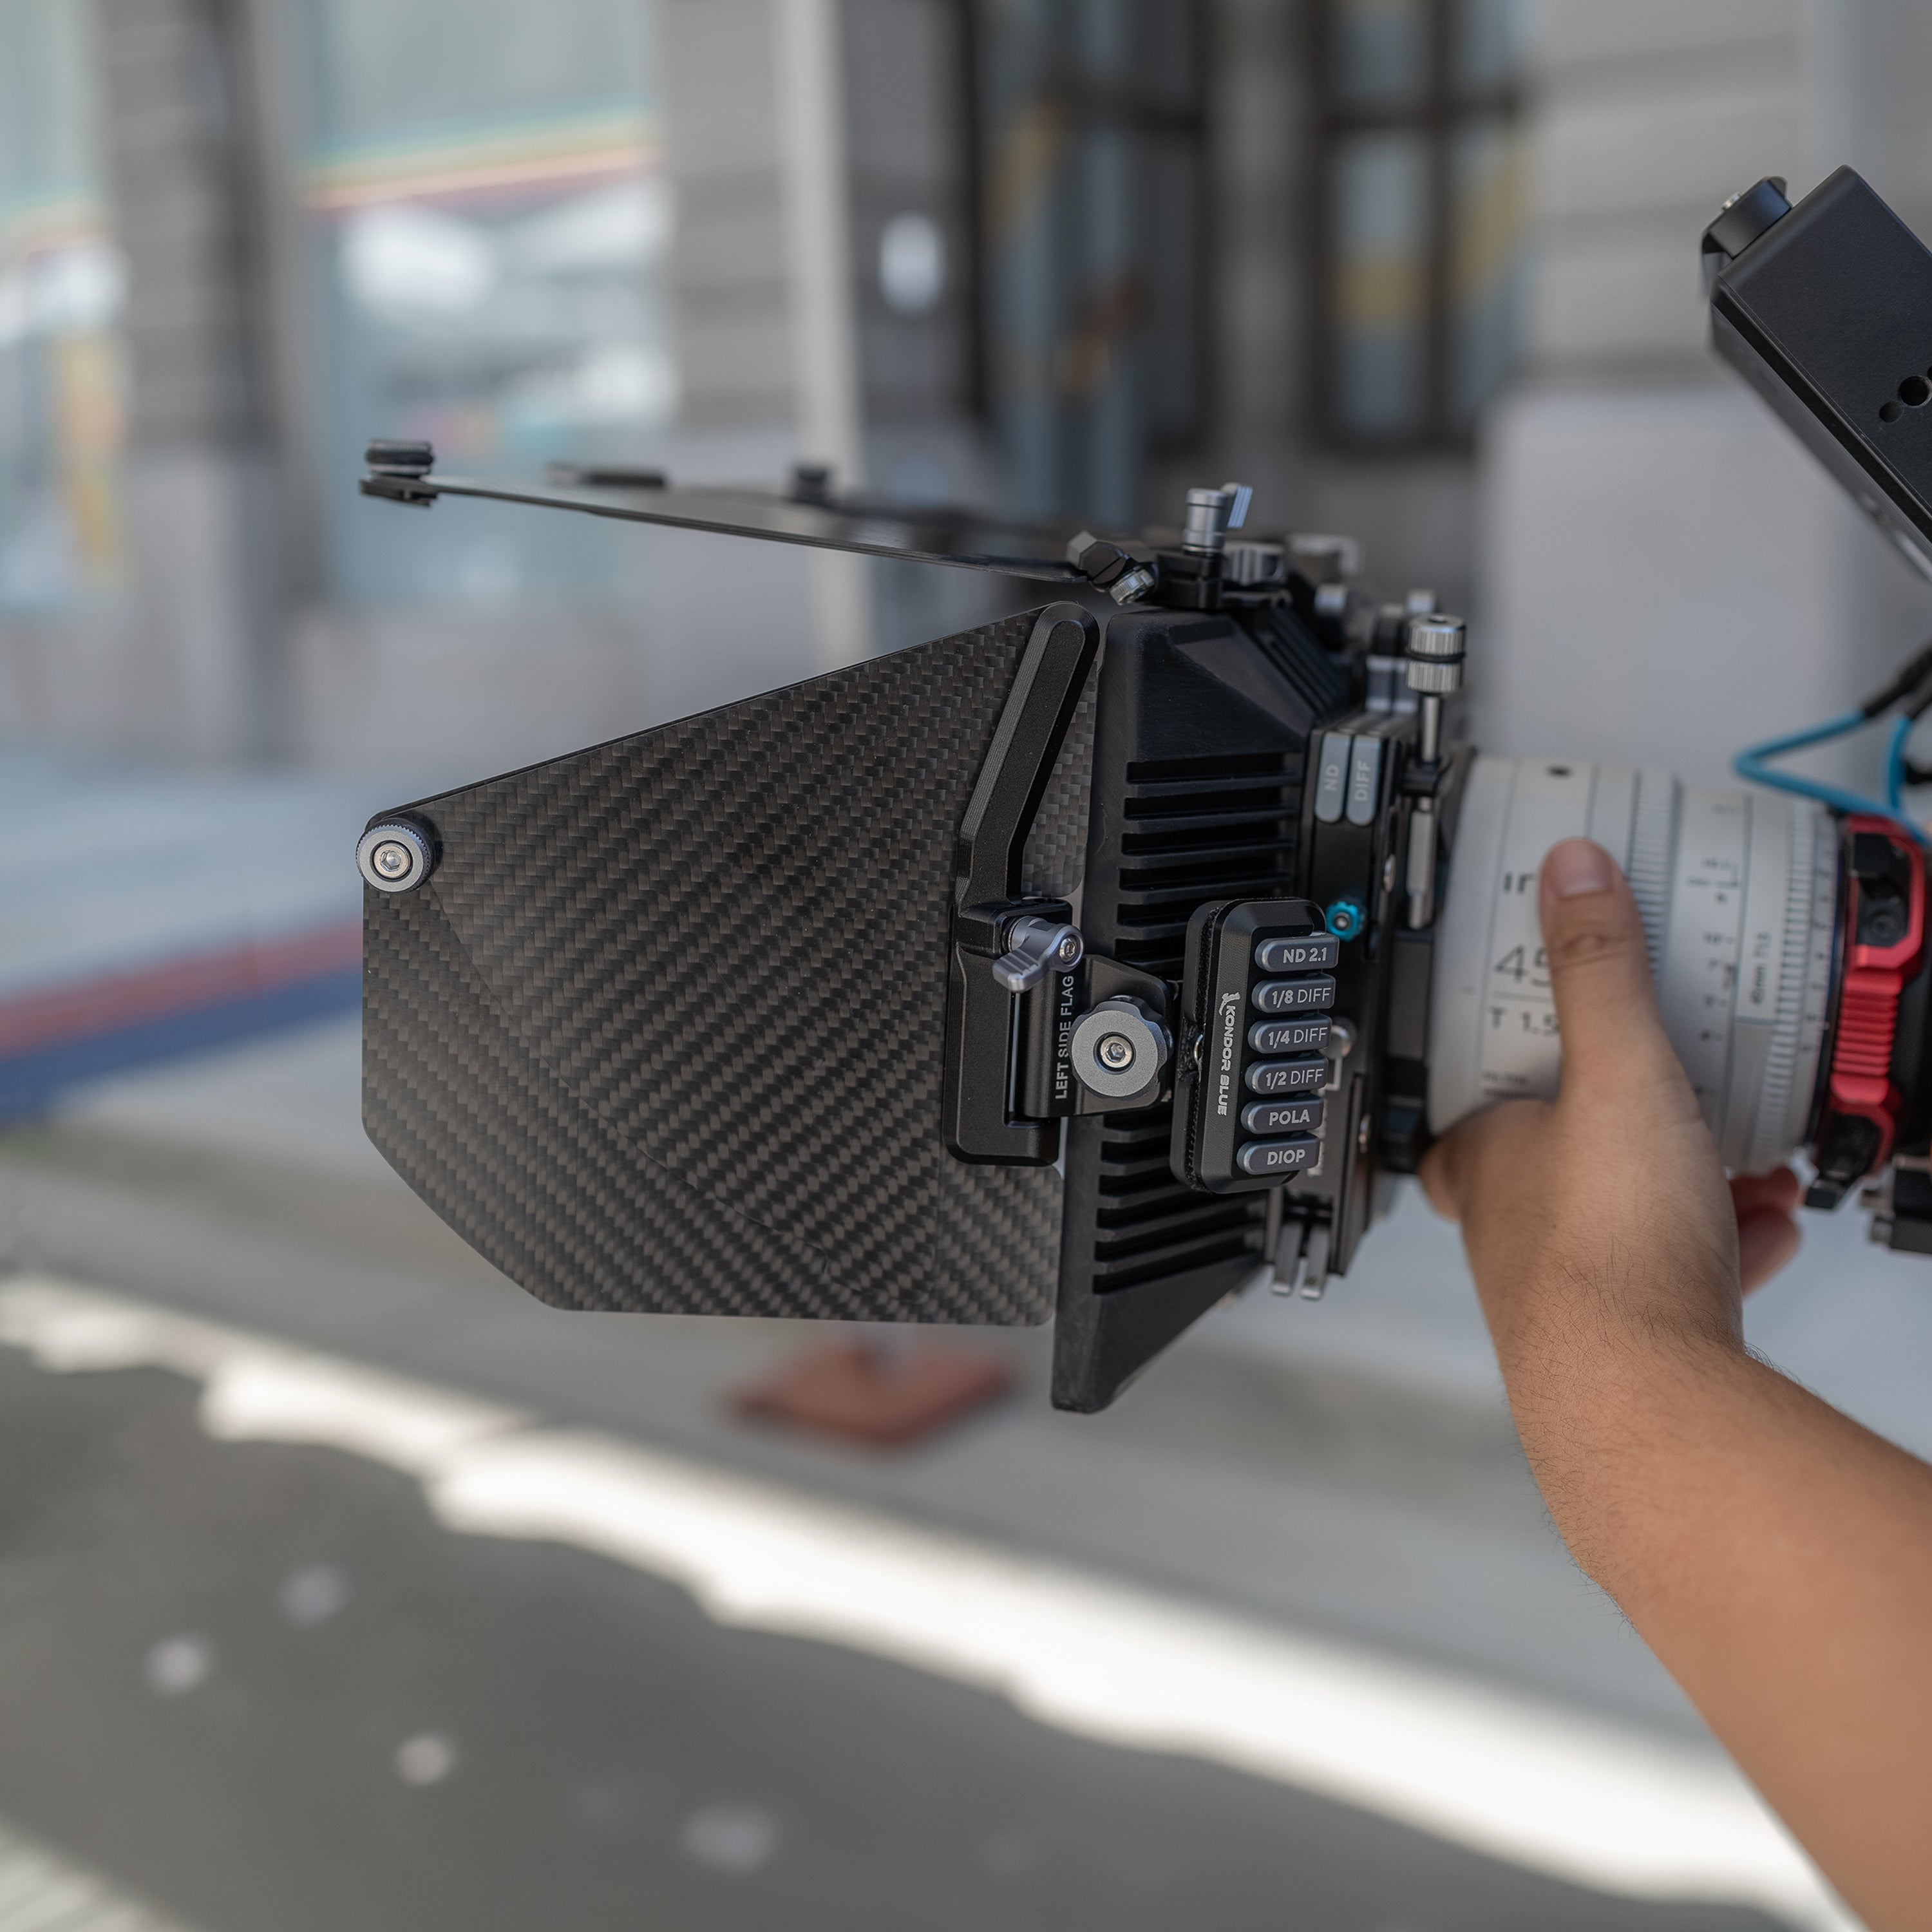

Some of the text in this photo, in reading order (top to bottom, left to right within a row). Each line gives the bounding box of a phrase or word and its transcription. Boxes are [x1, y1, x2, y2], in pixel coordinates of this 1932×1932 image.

[1323, 764, 1340, 791] ND
[1354, 759, 1371, 801] DIFF
[1283, 947, 1327, 963] ND 2.1
[1272, 987, 1332, 1009] 1/8 DIFF
[1055, 975, 1075, 1100] LEFT SIDE FLAG
[1268, 1027, 1328, 1049] 1/4 DIFF
[1217, 1005, 1236, 1116] KONDOR BLUE
[1265, 1068, 1324, 1090] 1/2 DIFF
[1269, 1109, 1311, 1126] POLA
[1267, 1149, 1306, 1166] DIOP
